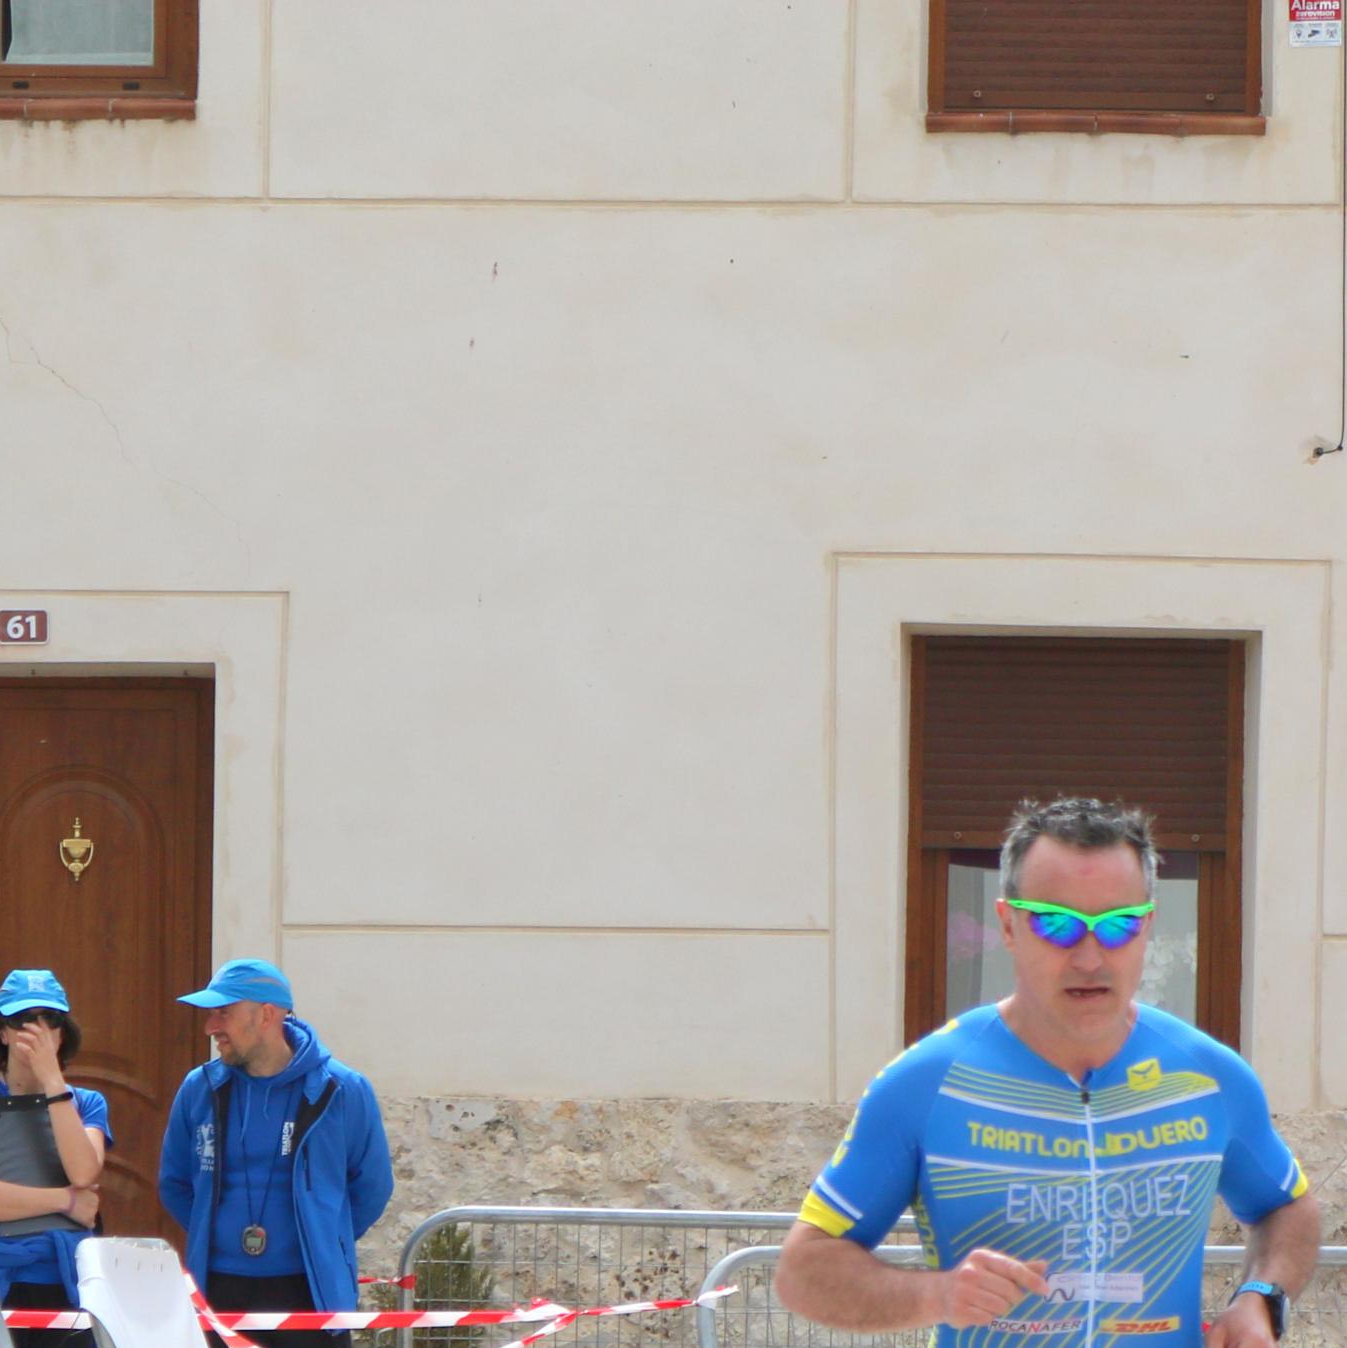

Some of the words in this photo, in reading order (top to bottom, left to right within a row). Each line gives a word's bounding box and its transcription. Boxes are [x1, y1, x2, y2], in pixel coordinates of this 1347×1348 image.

[1291, 0, 1340, 10] Alarma
[6, 615, 37, 639] 61
[1006, 1174, 1191, 1224] ENRIQUEZ
[1061, 1221, 1133, 1260] ESP
[1114, 1321, 1171, 1333] DHL
